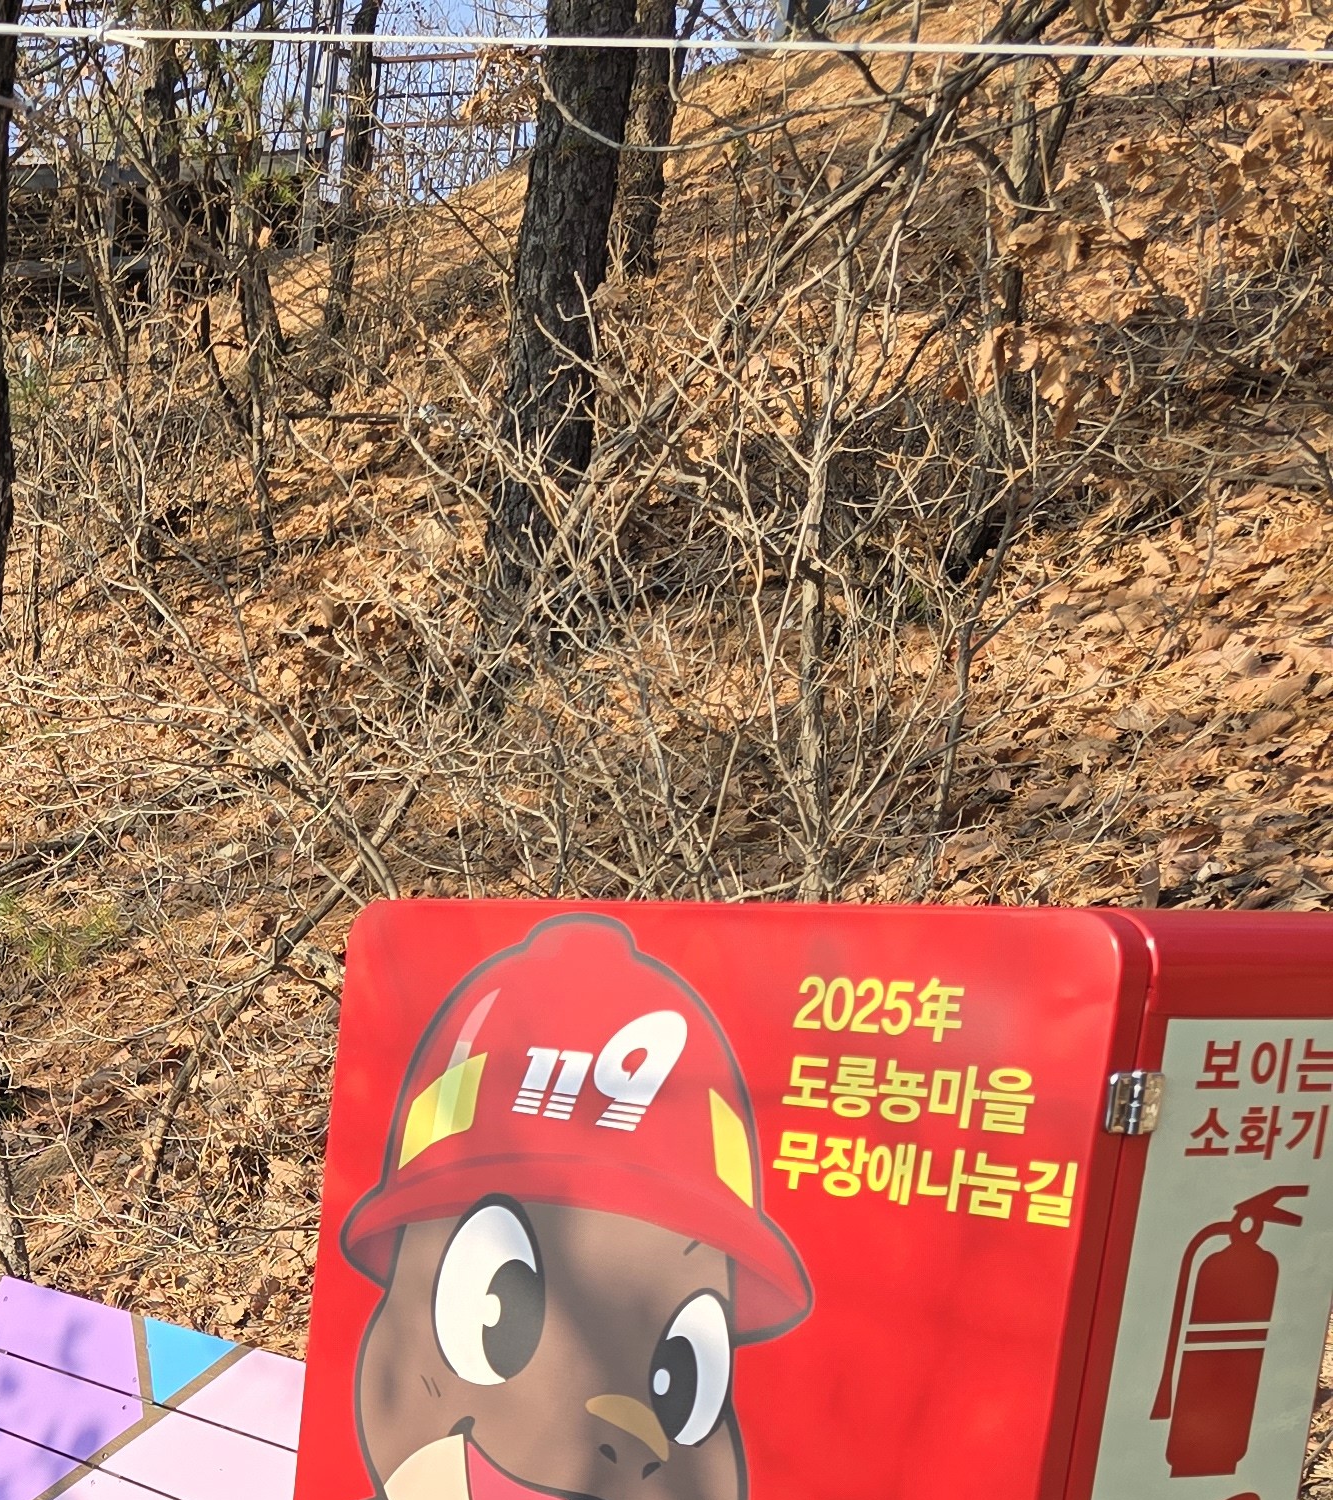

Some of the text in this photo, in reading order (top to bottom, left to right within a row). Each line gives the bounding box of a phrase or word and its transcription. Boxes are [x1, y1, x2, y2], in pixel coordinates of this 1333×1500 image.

[793, 976, 965, 1042] 2025年
[511, 1010, 688, 1131] 119
[782, 1054, 1035, 1135] 도롱뇽마을
[1195, 1038, 1333, 1093] 보이는
[1184, 1105, 1330, 1160] 소화기
[773, 1131, 1078, 1228] 무장애나눔길
